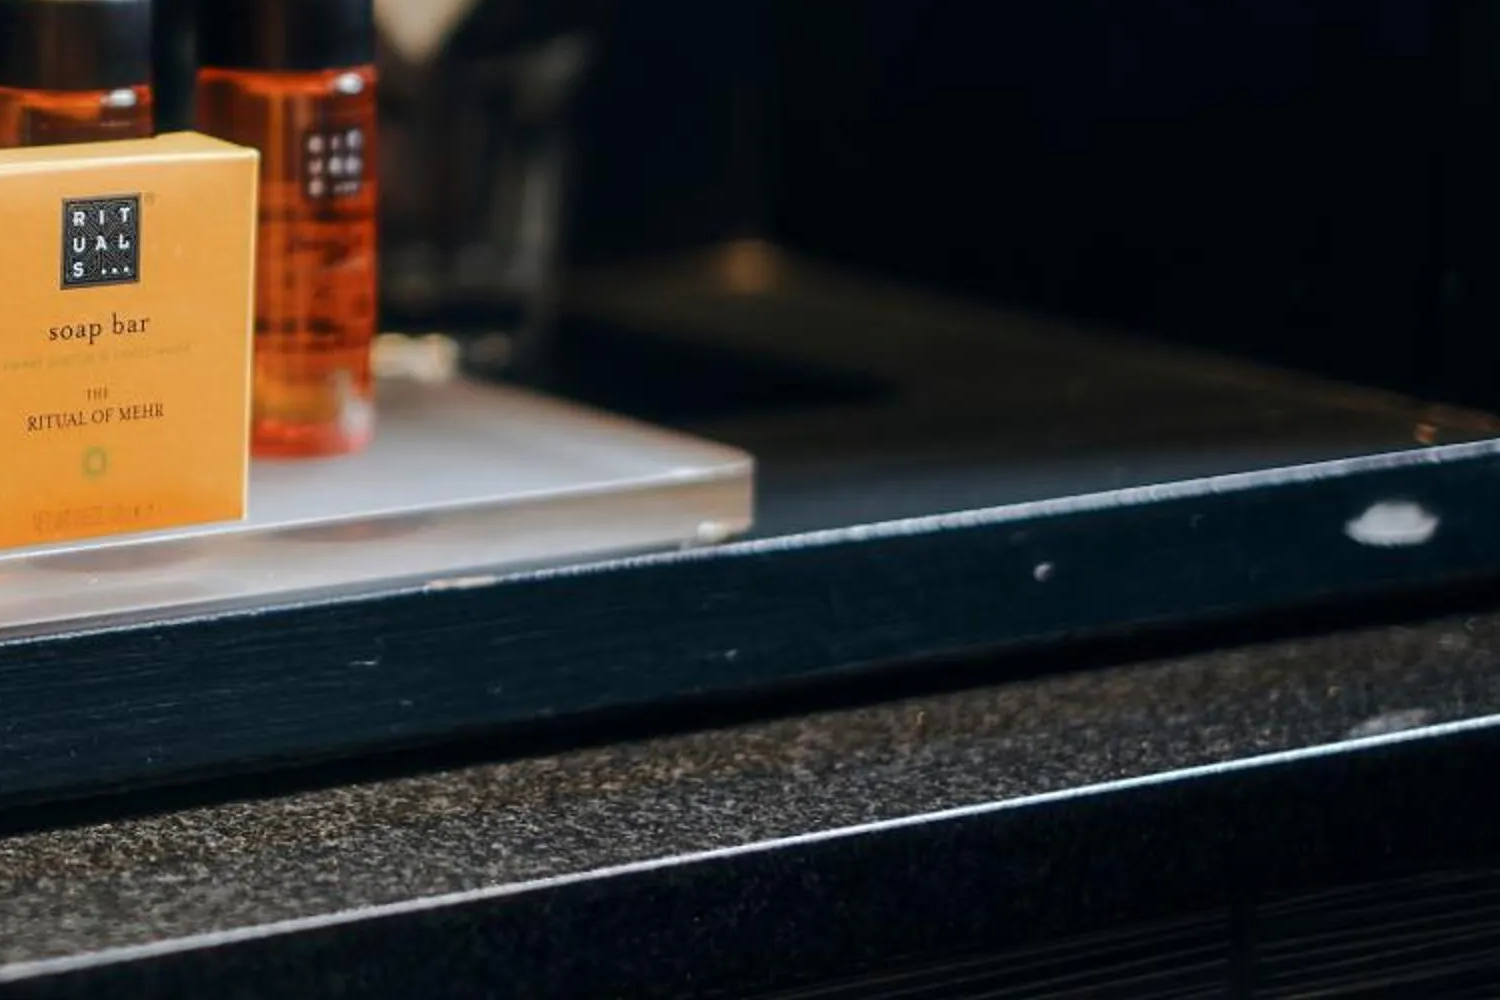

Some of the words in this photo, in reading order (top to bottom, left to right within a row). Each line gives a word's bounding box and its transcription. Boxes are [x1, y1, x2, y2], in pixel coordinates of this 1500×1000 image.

[49, 323, 102, 345] soap
[112, 312, 150, 335] bar
[27, 410, 87, 432] RITUAL
[90, 406, 116, 425] OF
[118, 402, 164, 421] MEHR
